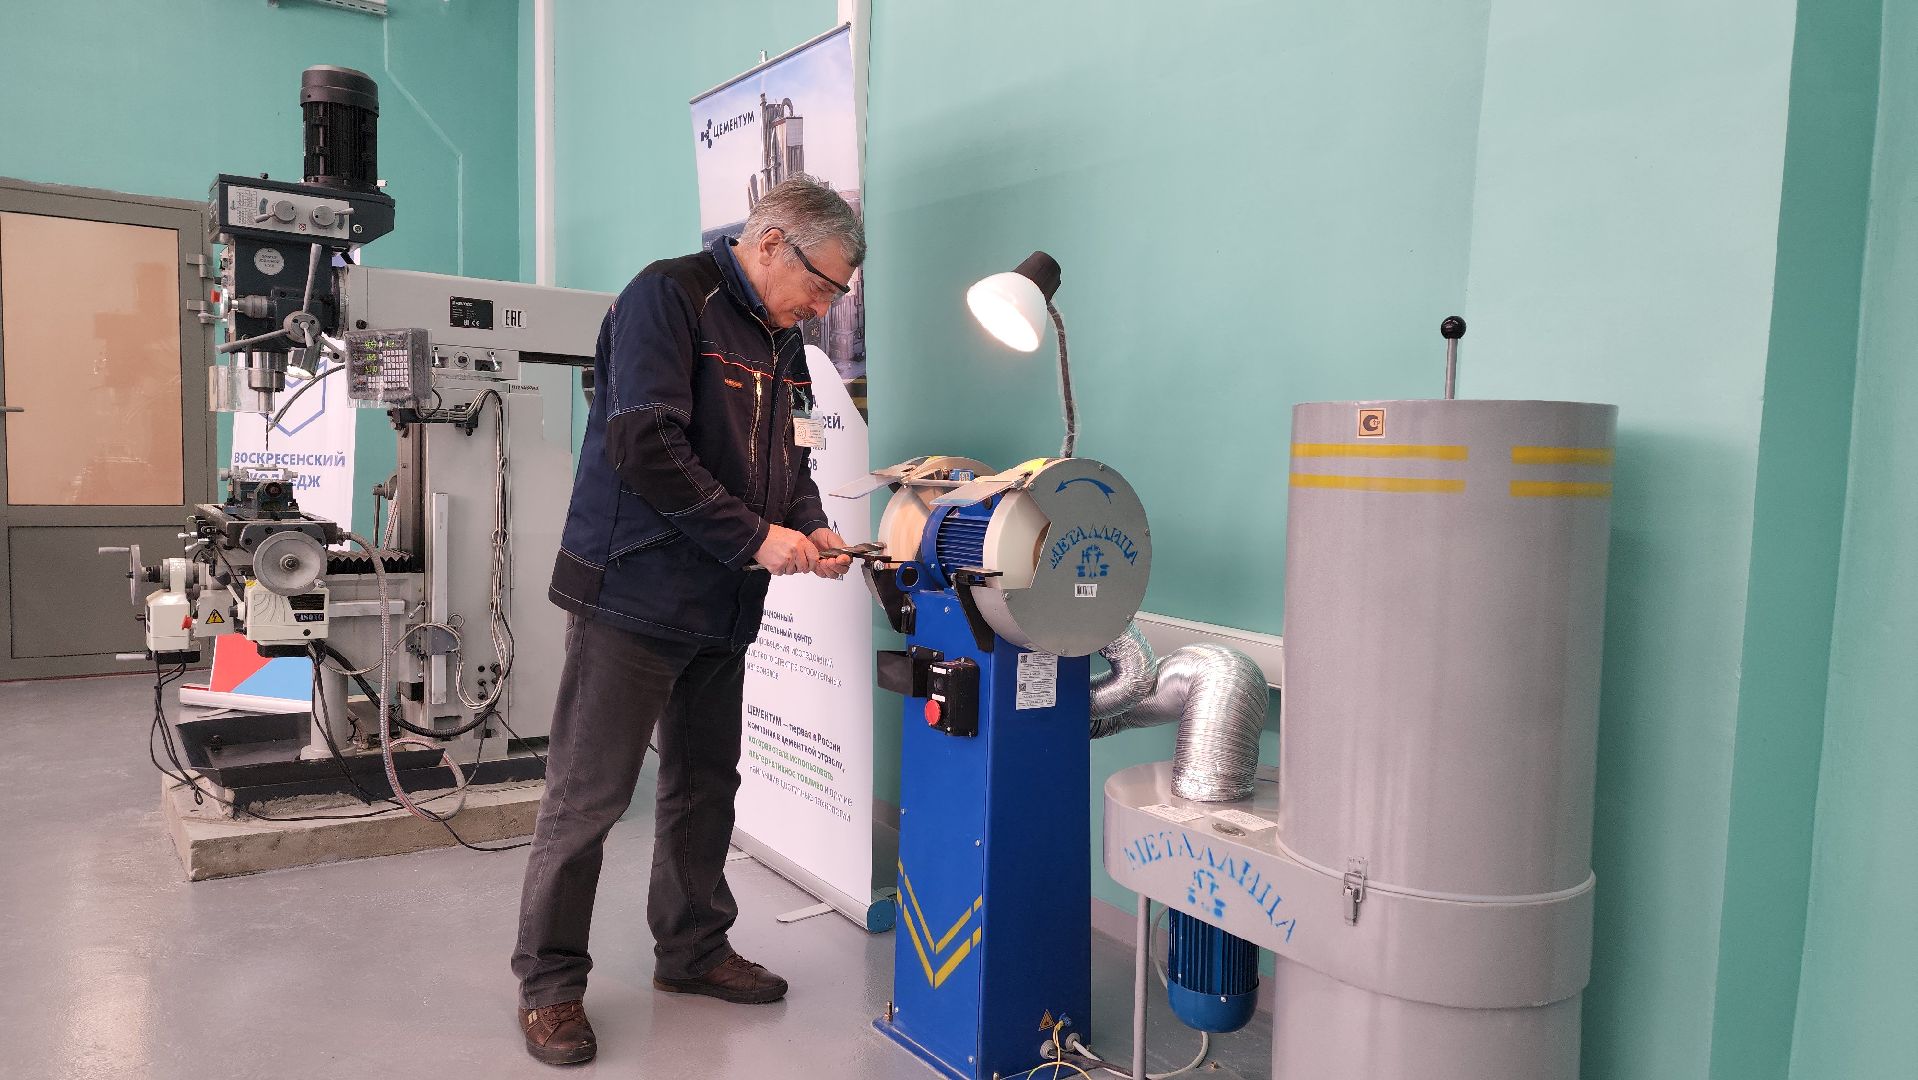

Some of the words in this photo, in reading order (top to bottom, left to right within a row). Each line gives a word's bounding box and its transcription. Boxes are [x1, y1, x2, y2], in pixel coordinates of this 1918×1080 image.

[713, 110, 755, 139] ЦЕМЕНТУМ
[234, 451, 346, 467] ВОСКРЕСЕНСКИЙ
[793, 632, 813, 646] центр
[747, 703, 782, 727] ЦЕМЕНТУМ
[789, 723, 812, 740] первая
[817, 732, 841, 754] России
[747, 720, 777, 740] компания
[781, 735, 817, 758] цементной
[748, 735, 772, 752] которая
[772, 745, 789, 760] стала
[789, 753, 834, 782] использовать
[748, 749, 796, 779] альтернативное
[796, 772, 824, 792] топливо
